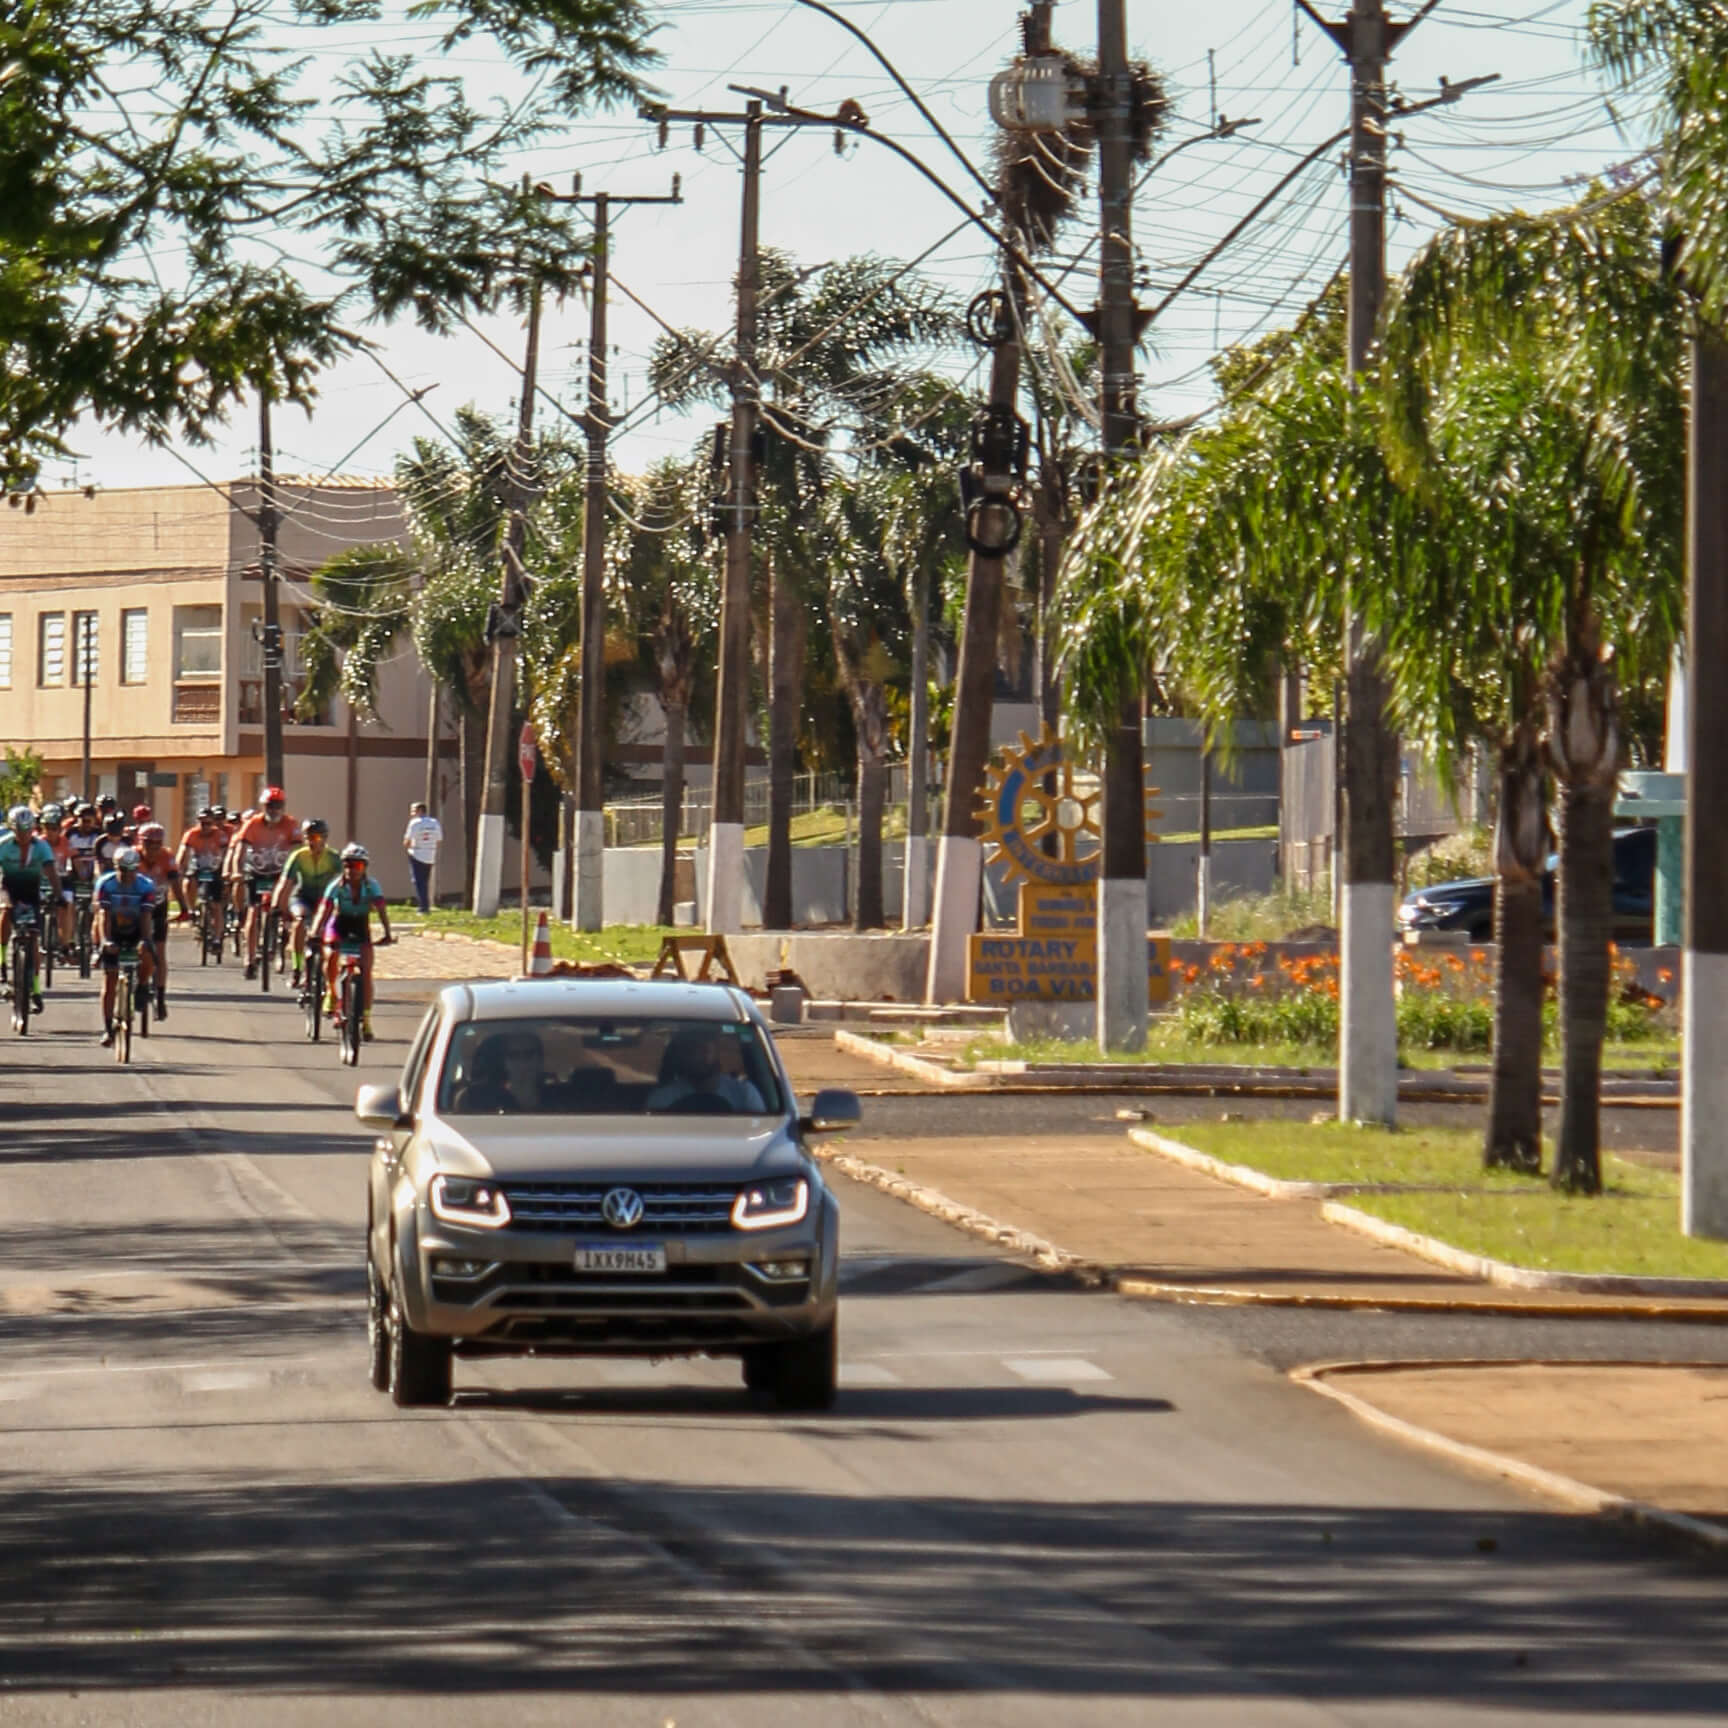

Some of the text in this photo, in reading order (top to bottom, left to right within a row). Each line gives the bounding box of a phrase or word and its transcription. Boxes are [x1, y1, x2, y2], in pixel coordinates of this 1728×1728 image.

[981, 940, 1076, 958] ROTARY
[990, 978, 1093, 994] BOA VIA
